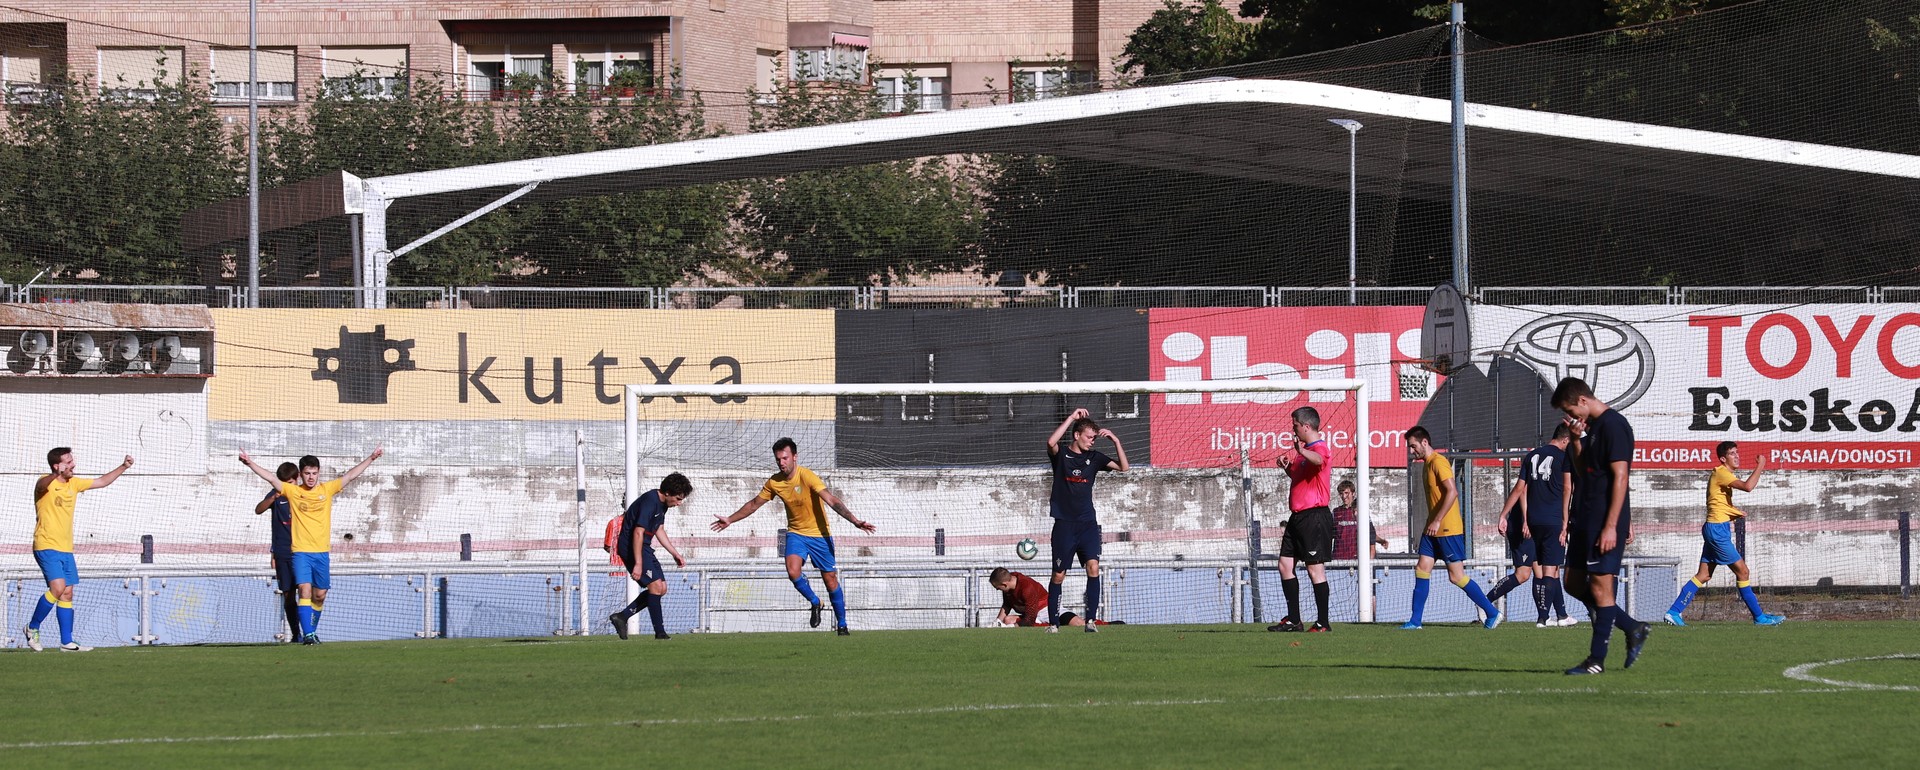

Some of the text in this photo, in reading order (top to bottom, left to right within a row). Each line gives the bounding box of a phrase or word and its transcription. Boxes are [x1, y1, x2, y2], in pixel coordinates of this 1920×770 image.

[1688, 312, 1920, 379] TOYO
[458, 332, 748, 405] kutxa
[1161, 328, 1436, 404] ibili
[1211, 426, 1407, 451] ibilimeje.om
[1530, 454, 1554, 481] 14
[1633, 448, 1711, 463] ELGOIBAR
[1770, 449, 1911, 464] PASAIA/DONOSTI
